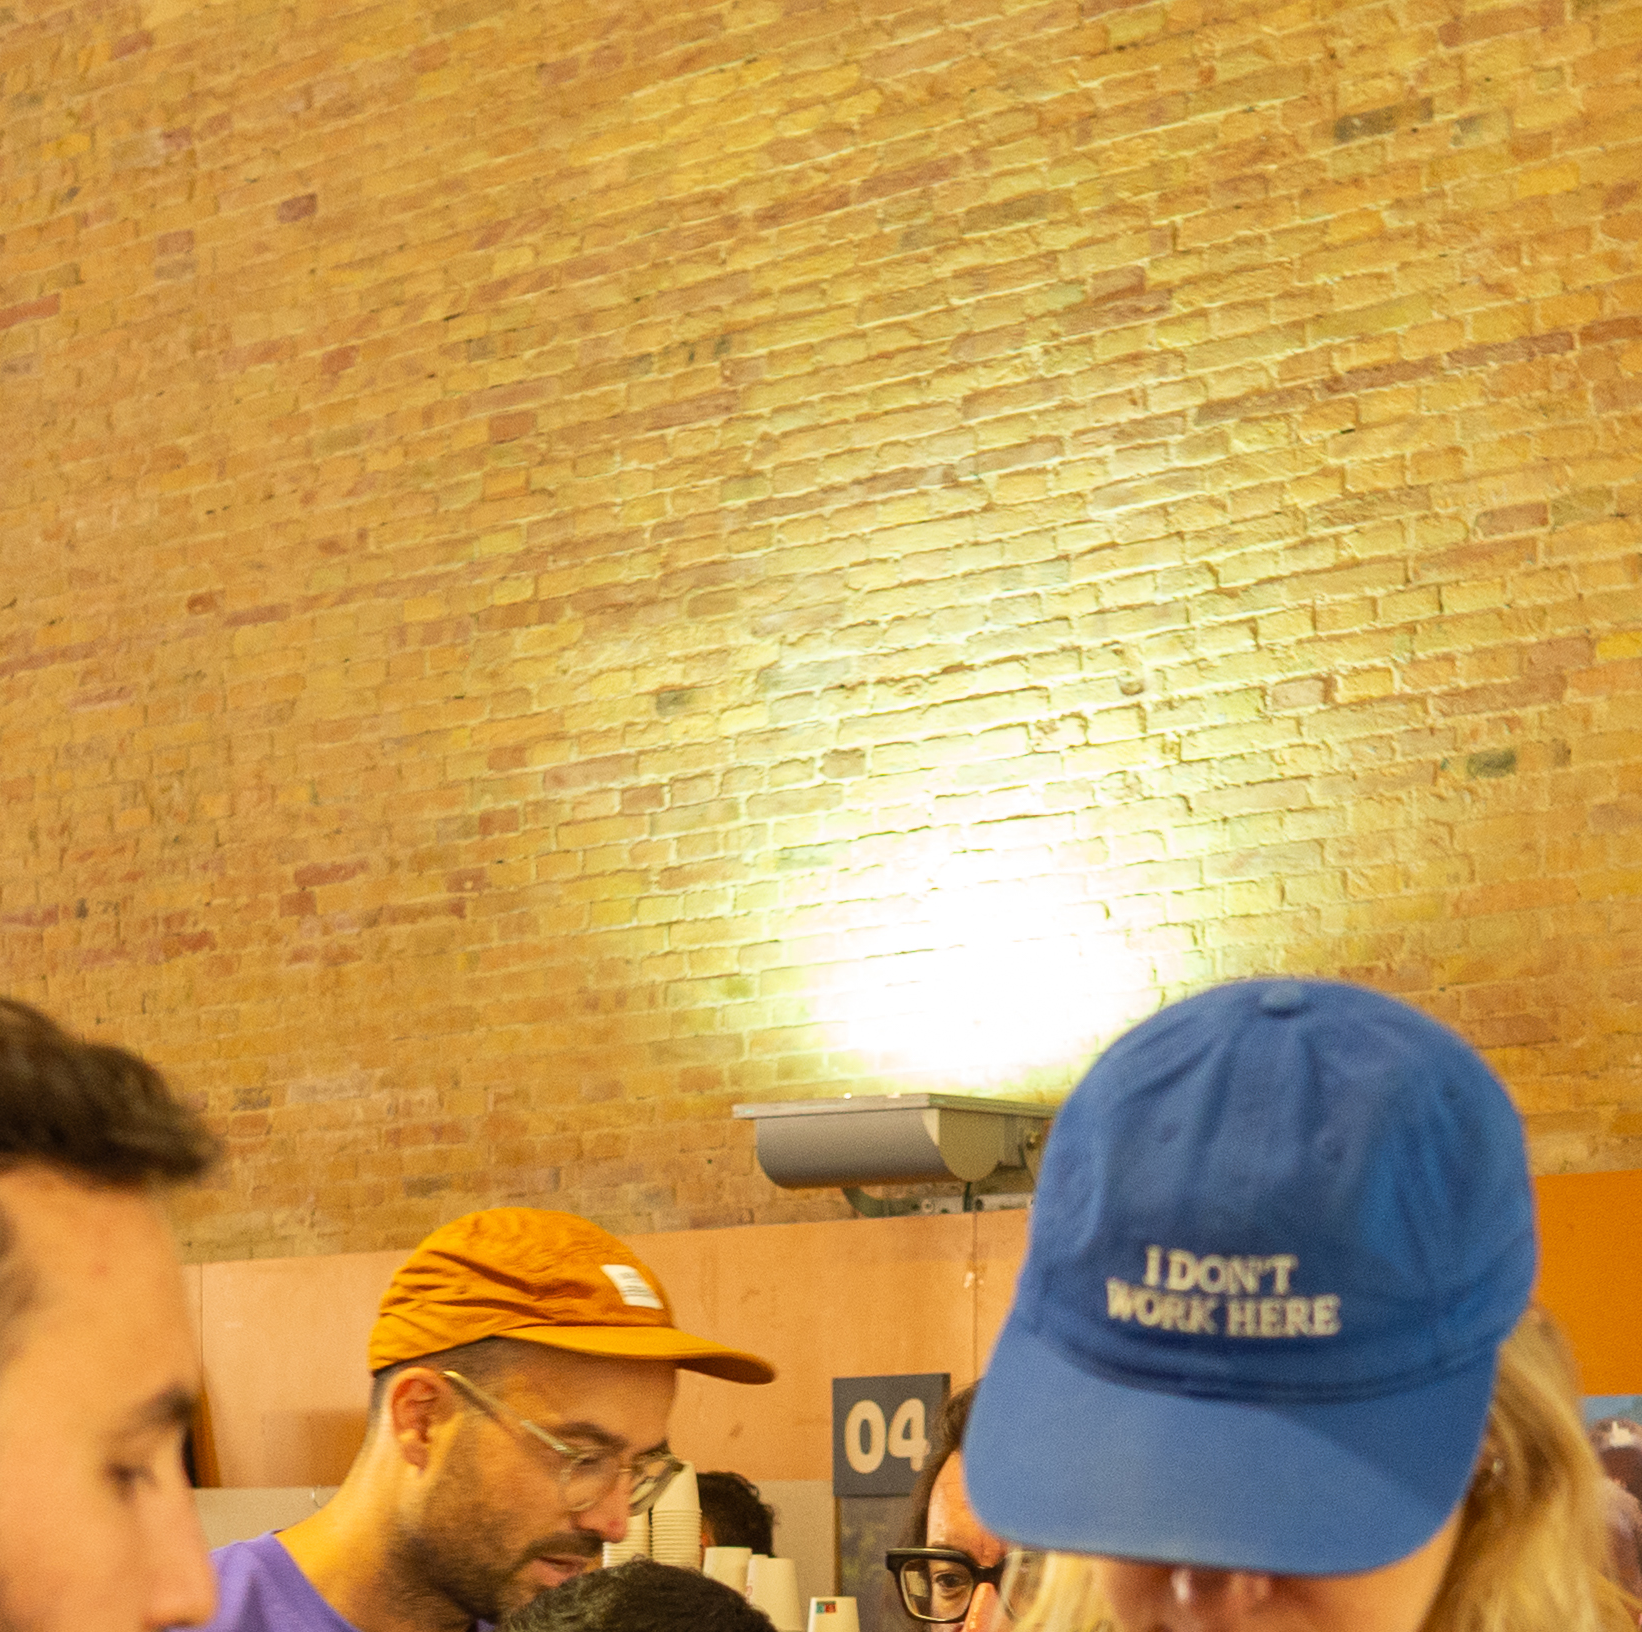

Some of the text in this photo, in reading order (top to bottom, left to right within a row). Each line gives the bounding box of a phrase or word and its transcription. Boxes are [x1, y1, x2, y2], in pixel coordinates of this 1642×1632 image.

[1143, 1244, 1300, 1296] I DON'T
[1106, 1277, 1343, 1338] WORK HERE
[844, 1398, 931, 1474] 04
